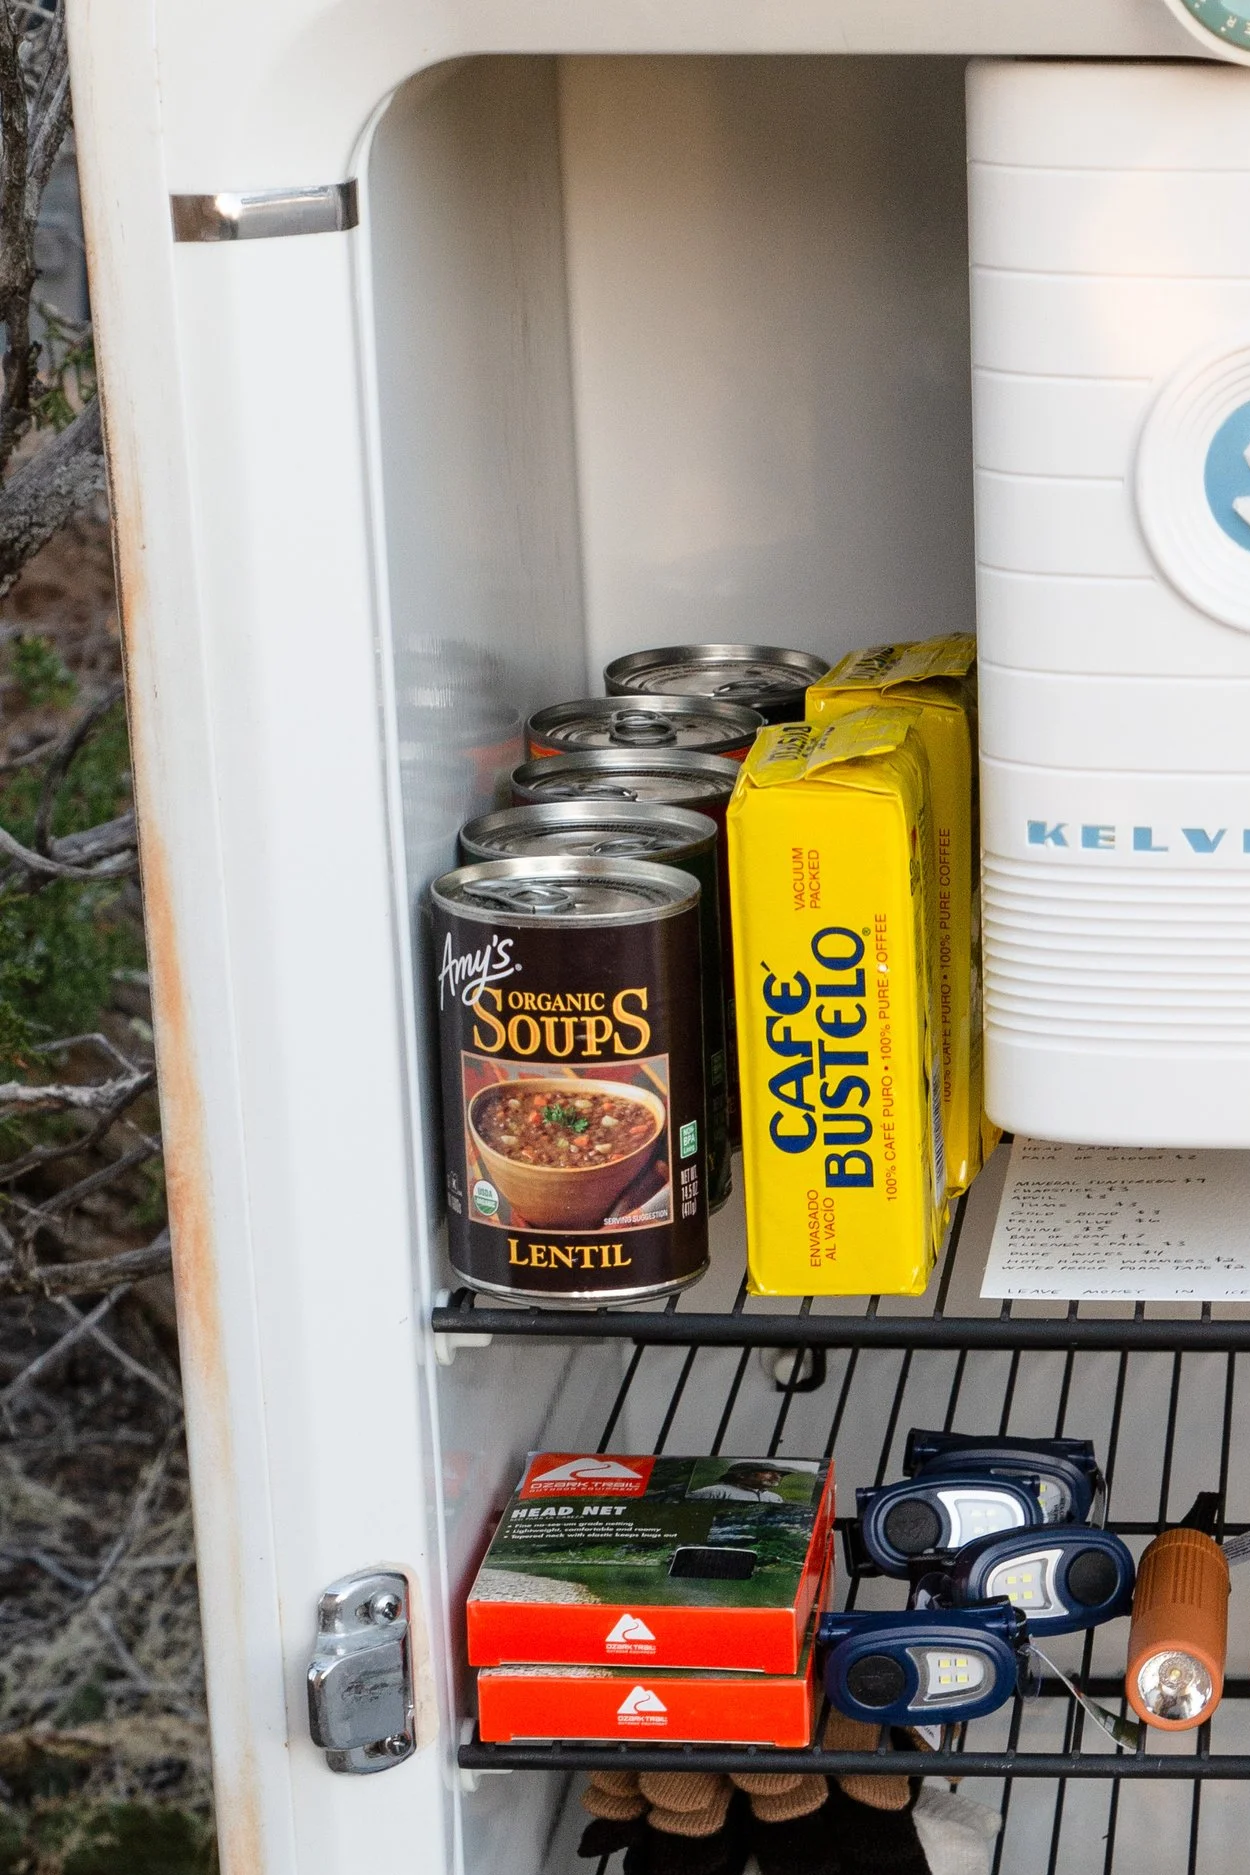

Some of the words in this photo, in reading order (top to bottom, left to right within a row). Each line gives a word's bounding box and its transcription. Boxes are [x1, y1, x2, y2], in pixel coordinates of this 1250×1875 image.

[794, 847, 805, 911] VACUUM
[809, 849, 820, 909] PACKED
[438, 932, 514, 1011] Amy's
[508, 991, 605, 1012] ORGANIC
[877, 978, 889, 1020] PURE
[472, 986, 651, 1057] SOUPS
[811, 926, 875, 1189] BUSTELO
[880, 1025, 891, 1061] 100%
[882, 1075, 894, 1118] PURO
[882, 1122, 896, 1163] CAFÉ
[887, 1168, 898, 1202] 100%
[603, 1214, 631, 1226] SERVING
[632, 1208, 668, 1222] SUGGESTION
[808, 1189, 821, 1268] ENVASADO
[508, 1238, 632, 1269] LENTIL
[827, 1243, 837, 1261] AL
[530, 1481, 590, 1489] OZARK
[511, 1507, 574, 1520] HEAD
[582, 1506, 627, 1516] NET
